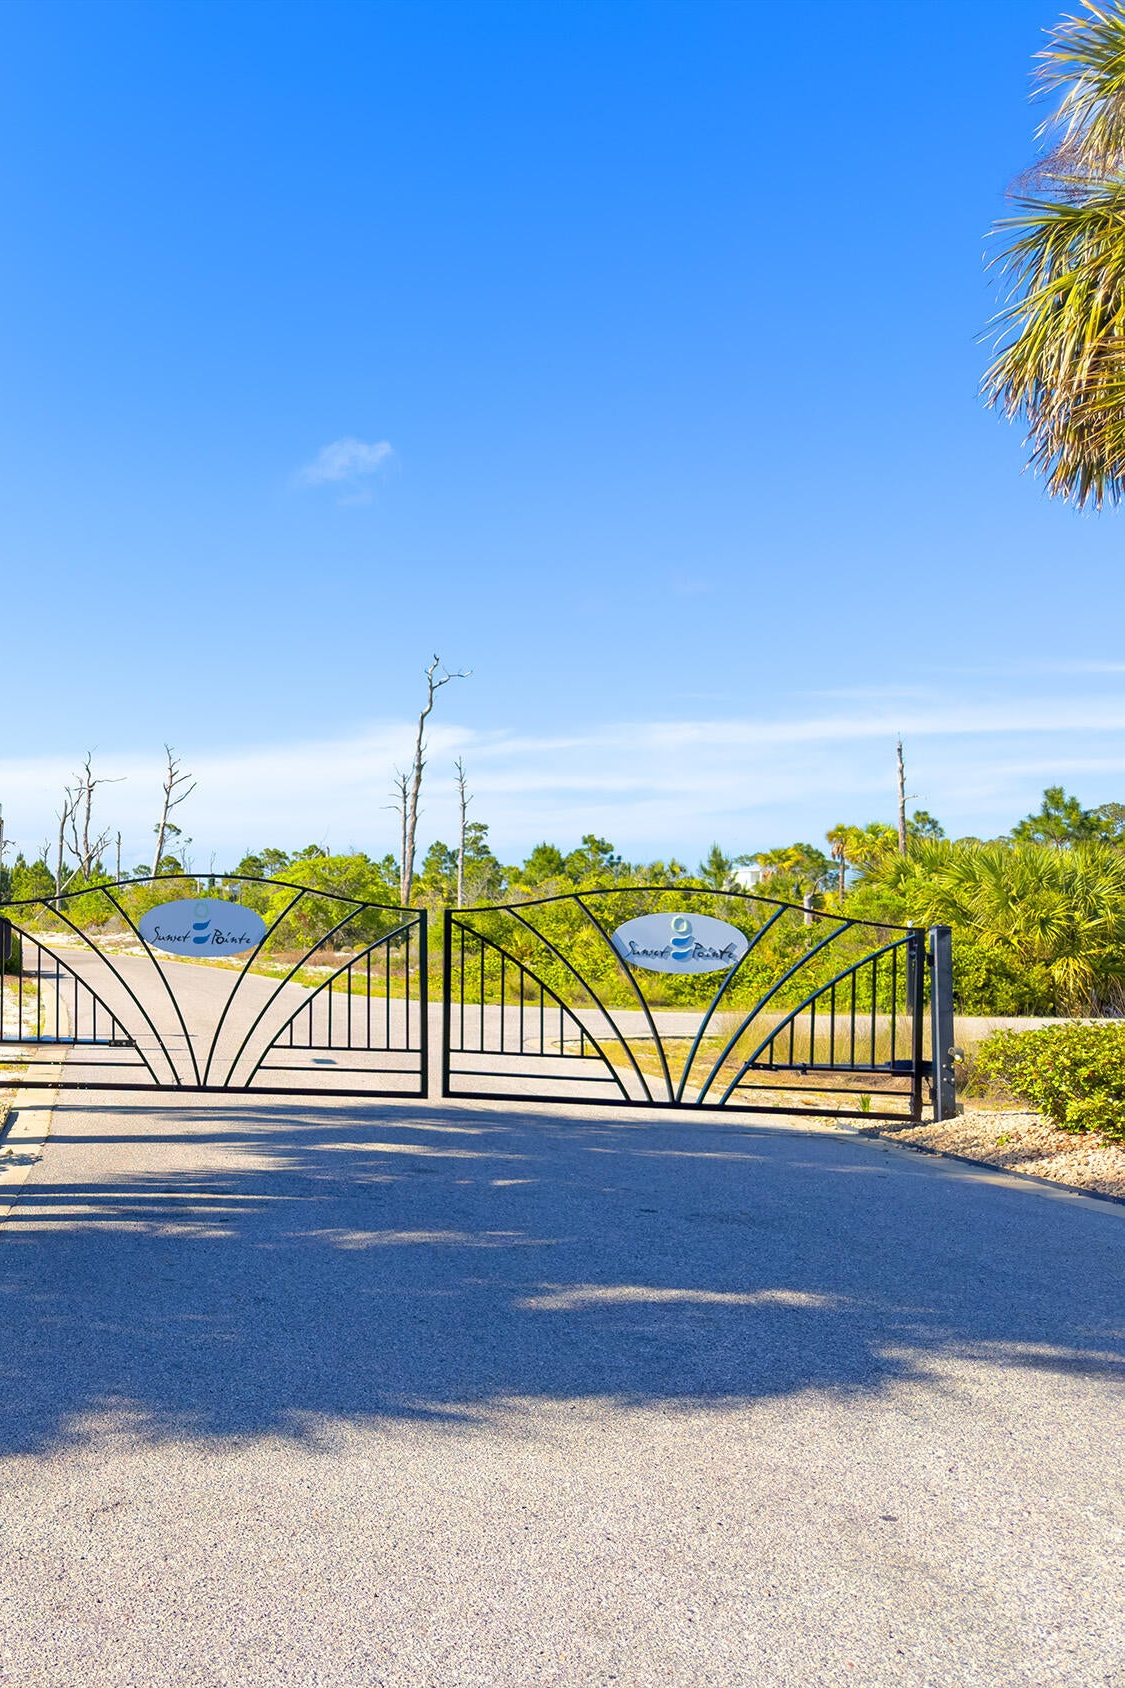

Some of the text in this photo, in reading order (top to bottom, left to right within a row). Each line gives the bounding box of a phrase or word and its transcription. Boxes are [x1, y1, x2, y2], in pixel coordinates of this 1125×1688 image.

[150, 926, 251, 945] Sunset Pointe
[625, 940, 733, 959] Sunset Pointe
